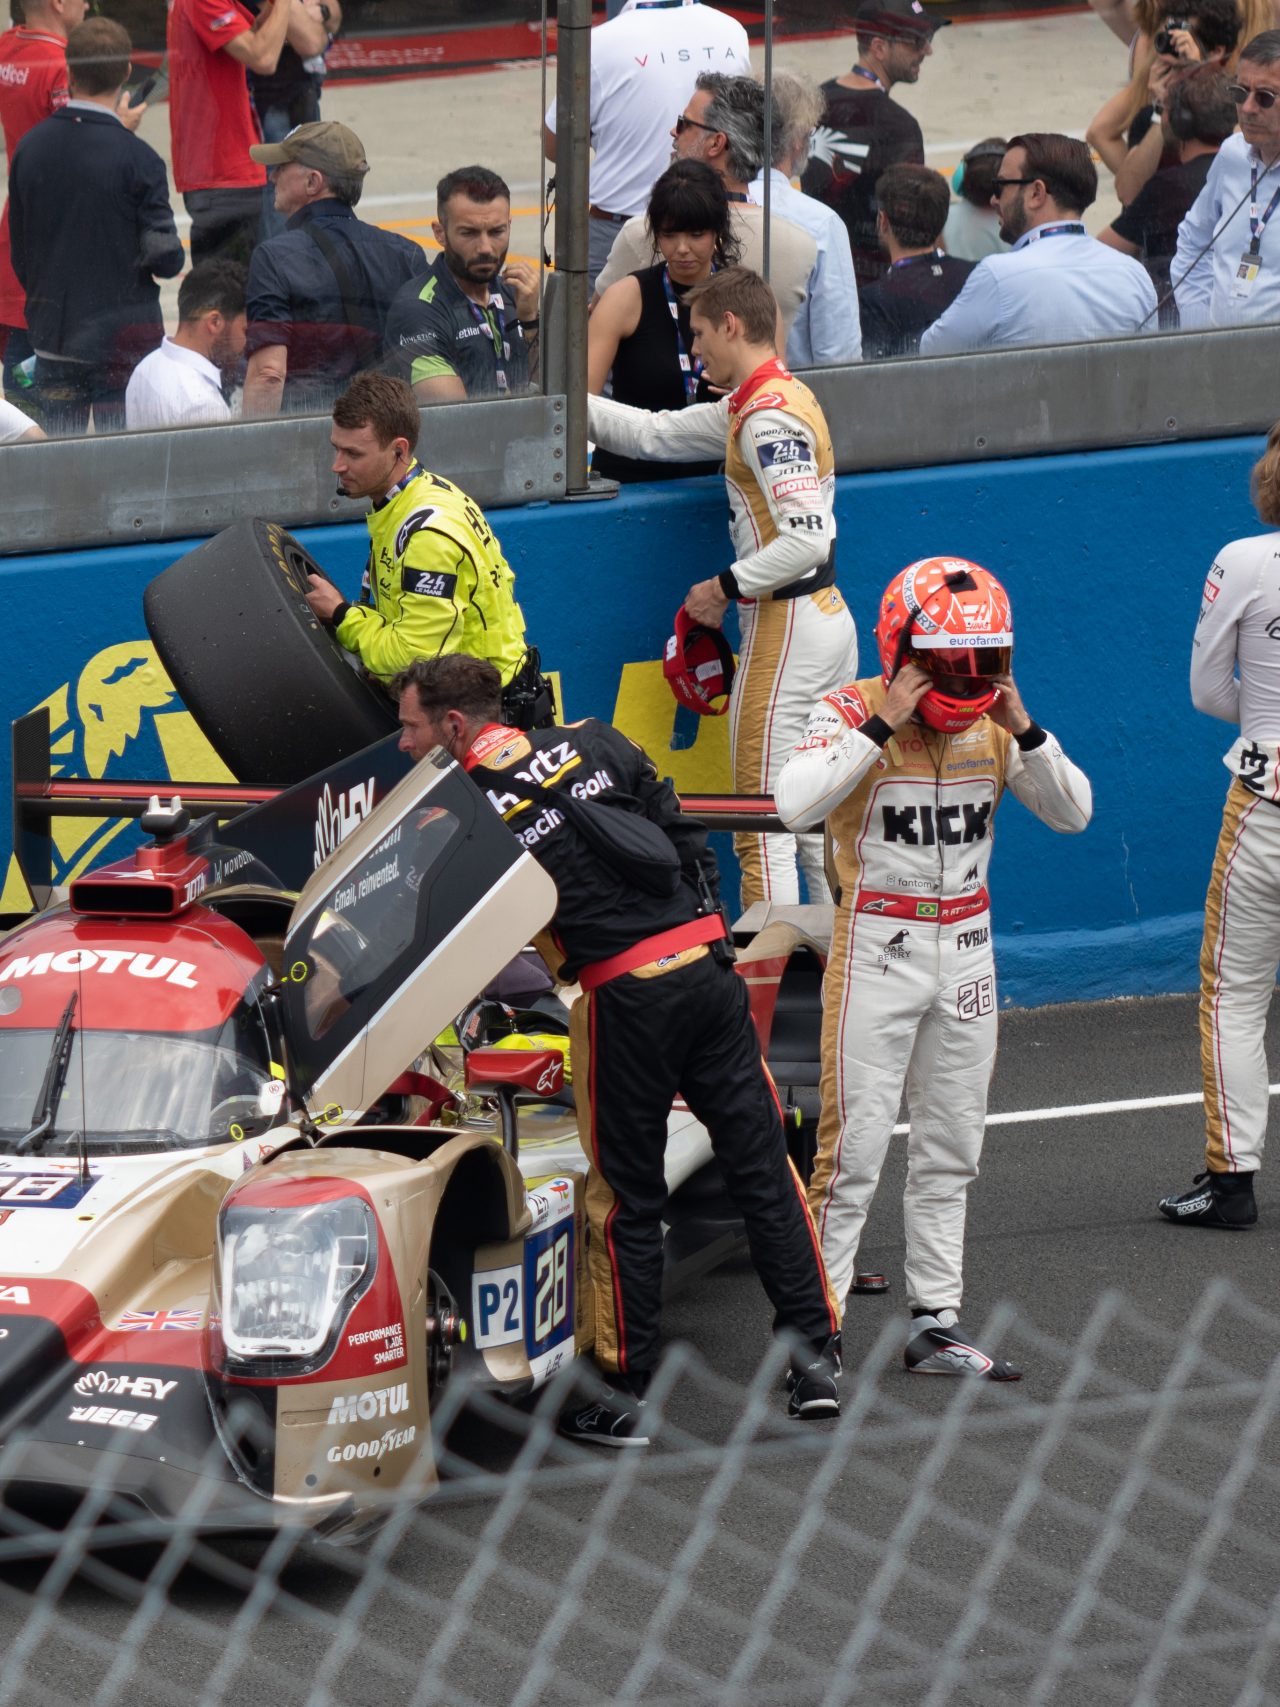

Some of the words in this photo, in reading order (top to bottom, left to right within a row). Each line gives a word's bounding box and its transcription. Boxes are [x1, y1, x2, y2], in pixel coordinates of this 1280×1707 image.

[634, 46, 735, 67] VISTA
[772, 440, 800, 458] 24h
[772, 464, 812, 478] JOTA
[776, 478, 818, 497] MOTUL
[789, 515, 823, 530] PR
[416, 571, 446, 591] 24h
[423, 588, 443, 596] MANS
[949, 635, 1004, 646] eurofarma
[946, 757, 995, 771] eurofarma
[882, 801, 992, 846] KICK
[180, 872, 206, 908] JOTA
[334, 881, 358, 913] Email,
[357, 854, 400, 899] reinvented.
[898, 877, 932, 889] fantom
[877, 951, 912, 962] BERRY
[883, 944, 904, 953] OAK
[957, 974, 995, 1021] 28
[533, 1230, 569, 1344] 28
[478, 1278, 520, 1337] P2
[347, 1322, 402, 1347] PERFORMANCE
[373, 1347, 405, 1365] SMARTER
[114, 1376, 179, 1400] HEY
[327, 1382, 410, 1425] MOTUL
[68, 1406, 159, 1432] JEGS
[327, 1425, 416, 1462] GOODYEAR
